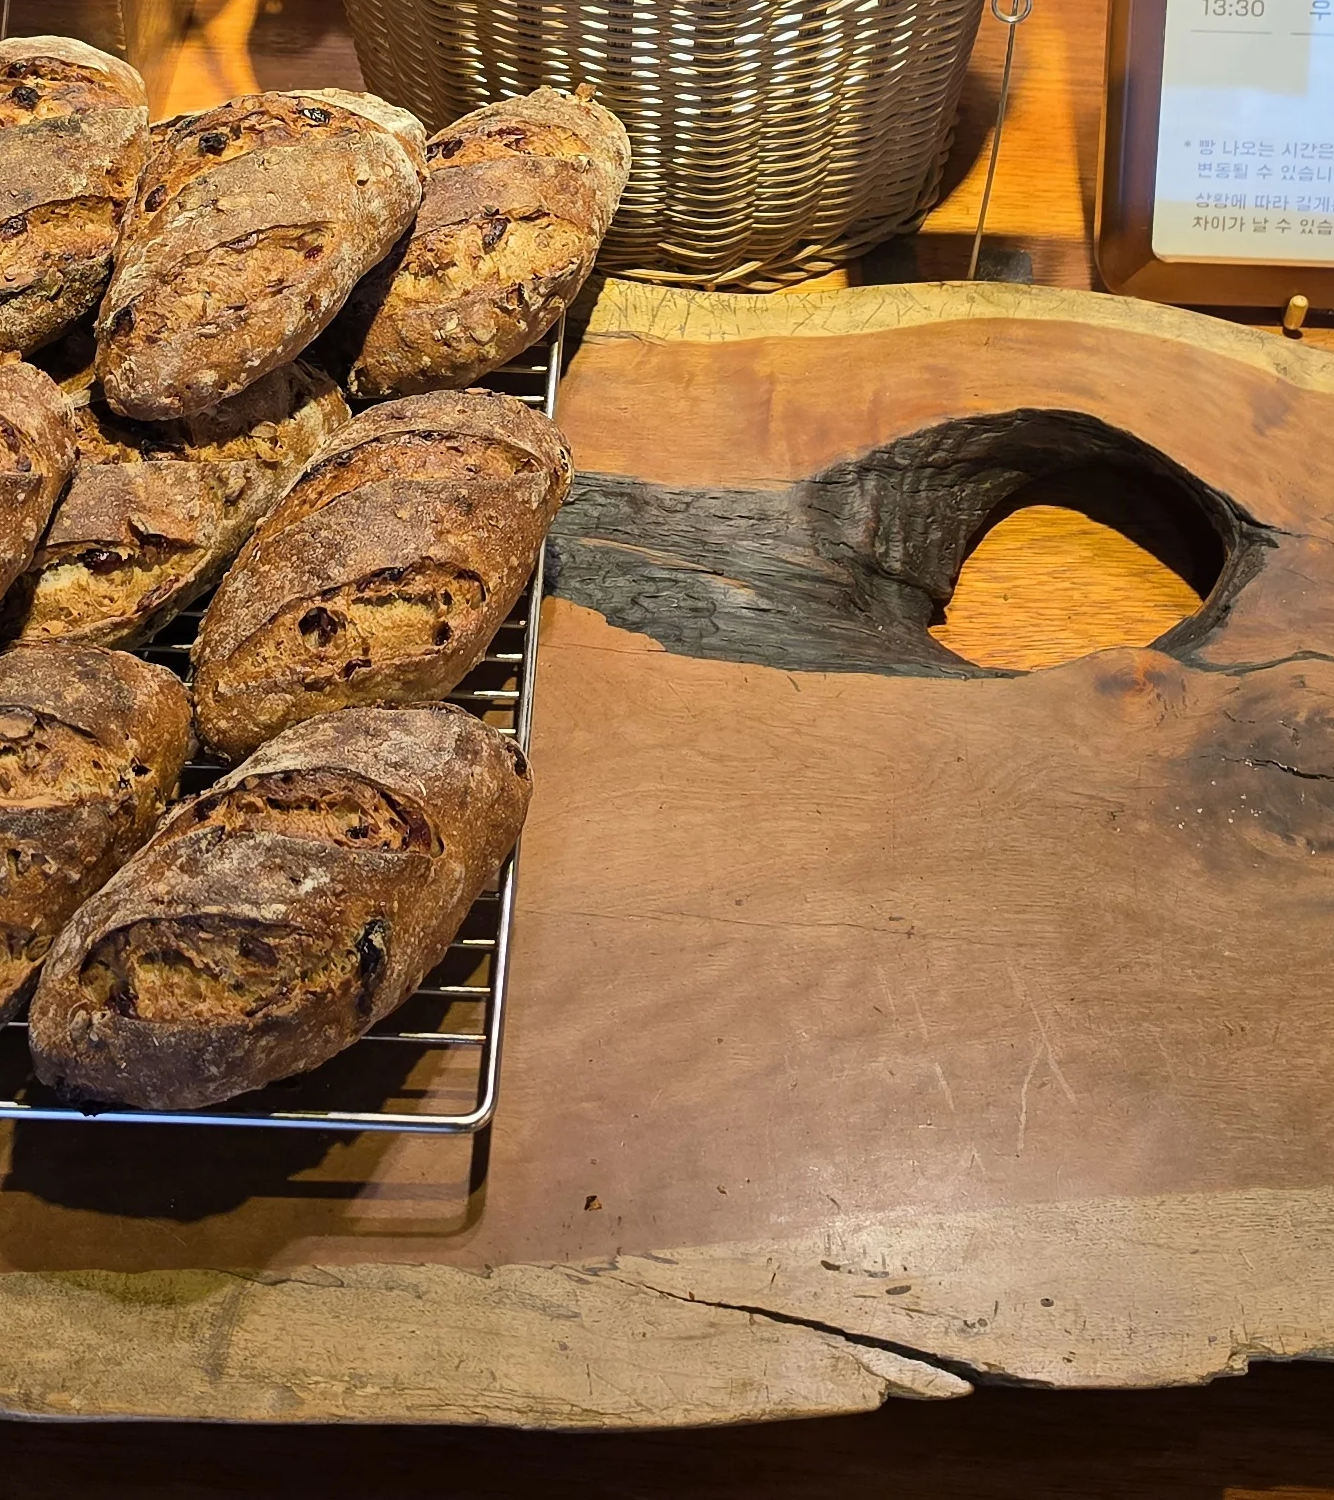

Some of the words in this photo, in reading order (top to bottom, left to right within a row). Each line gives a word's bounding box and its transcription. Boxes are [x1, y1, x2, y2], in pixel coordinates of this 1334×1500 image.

[1199, 140, 1216, 156] 빵
[1223, 140, 1275, 158] 나오는
[1282, 142, 1334, 160] 시간은
[1197, 162, 1249, 180] 변동될
[1256, 164, 1273, 180] 수
[1195, 192, 1247, 210] 상황에
[1255, 195, 1289, 211] 따라
[1192, 215, 1246, 232] 차이가
[1252, 217, 1269, 233] 날
[1275, 218, 1292, 234] 수
